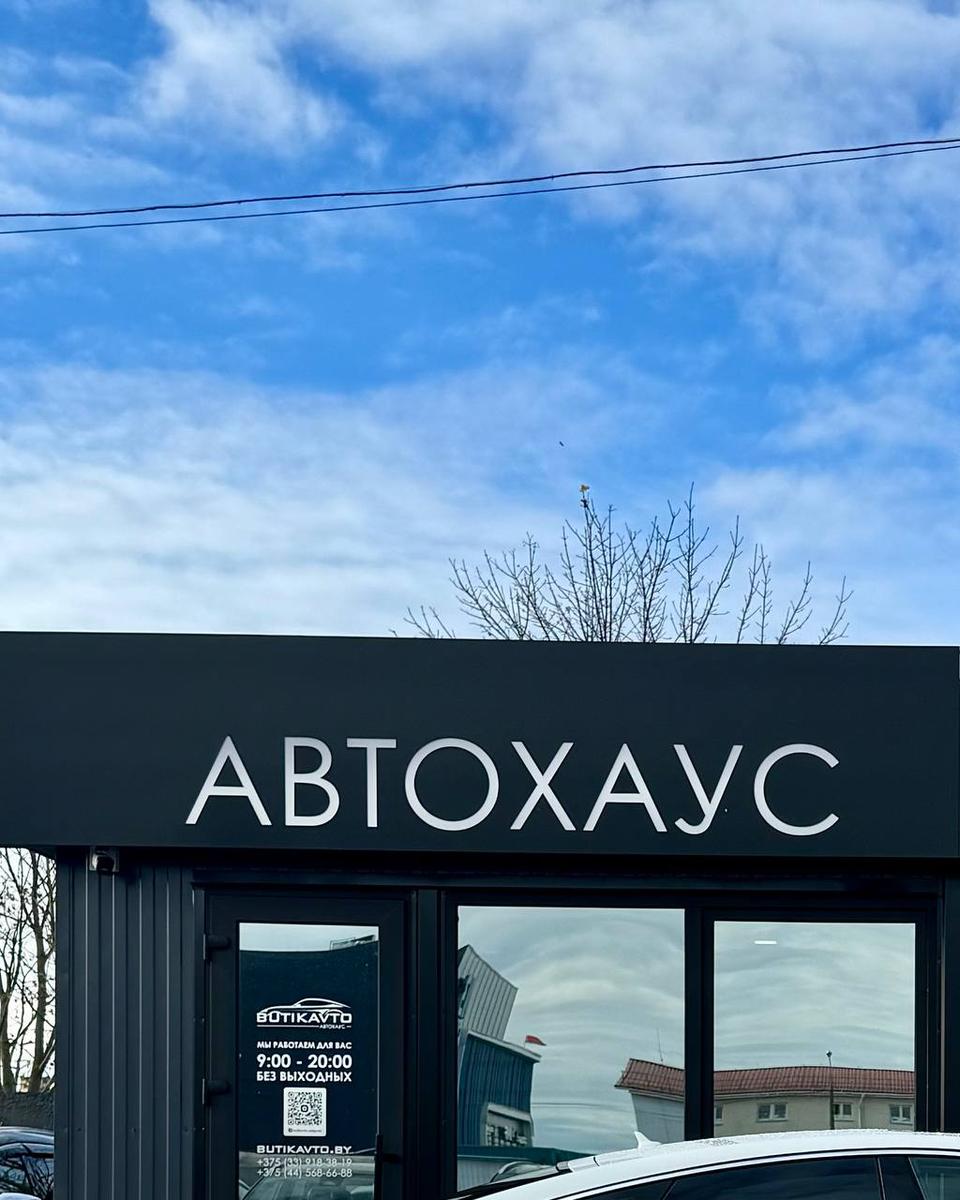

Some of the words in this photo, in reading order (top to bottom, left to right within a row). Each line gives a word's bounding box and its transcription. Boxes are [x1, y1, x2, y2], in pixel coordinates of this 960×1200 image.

[185, 735, 840, 837] АВТОХАУС
[256, 1012, 352, 1024] BUTIKAVTO
[256, 1041, 271, 1049] МЫ
[273, 1041, 315, 1049] РАБОТАЕМ
[316, 1041, 333, 1050] ДЛЯ
[335, 1041, 352, 1049] ВАС
[256, 1053, 291, 1069] 9:00
[307, 1054, 352, 1069] 20:00
[256, 1071, 276, 1082] БЕЗ
[280, 1071, 352, 1083] ВЫХОДНЫХ
[256, 1145, 352, 1154] BUTIKAVTO.BY
[257, 1158, 281, 1167] +375
[284, 1157, 302, 1168] (33)
[305, 1158, 352, 1167] 918-38-19
[257, 1168, 281, 1177] +375
[284, 1168, 302, 1179] (44)
[305, 1168, 352, 1178] 568-66-88
